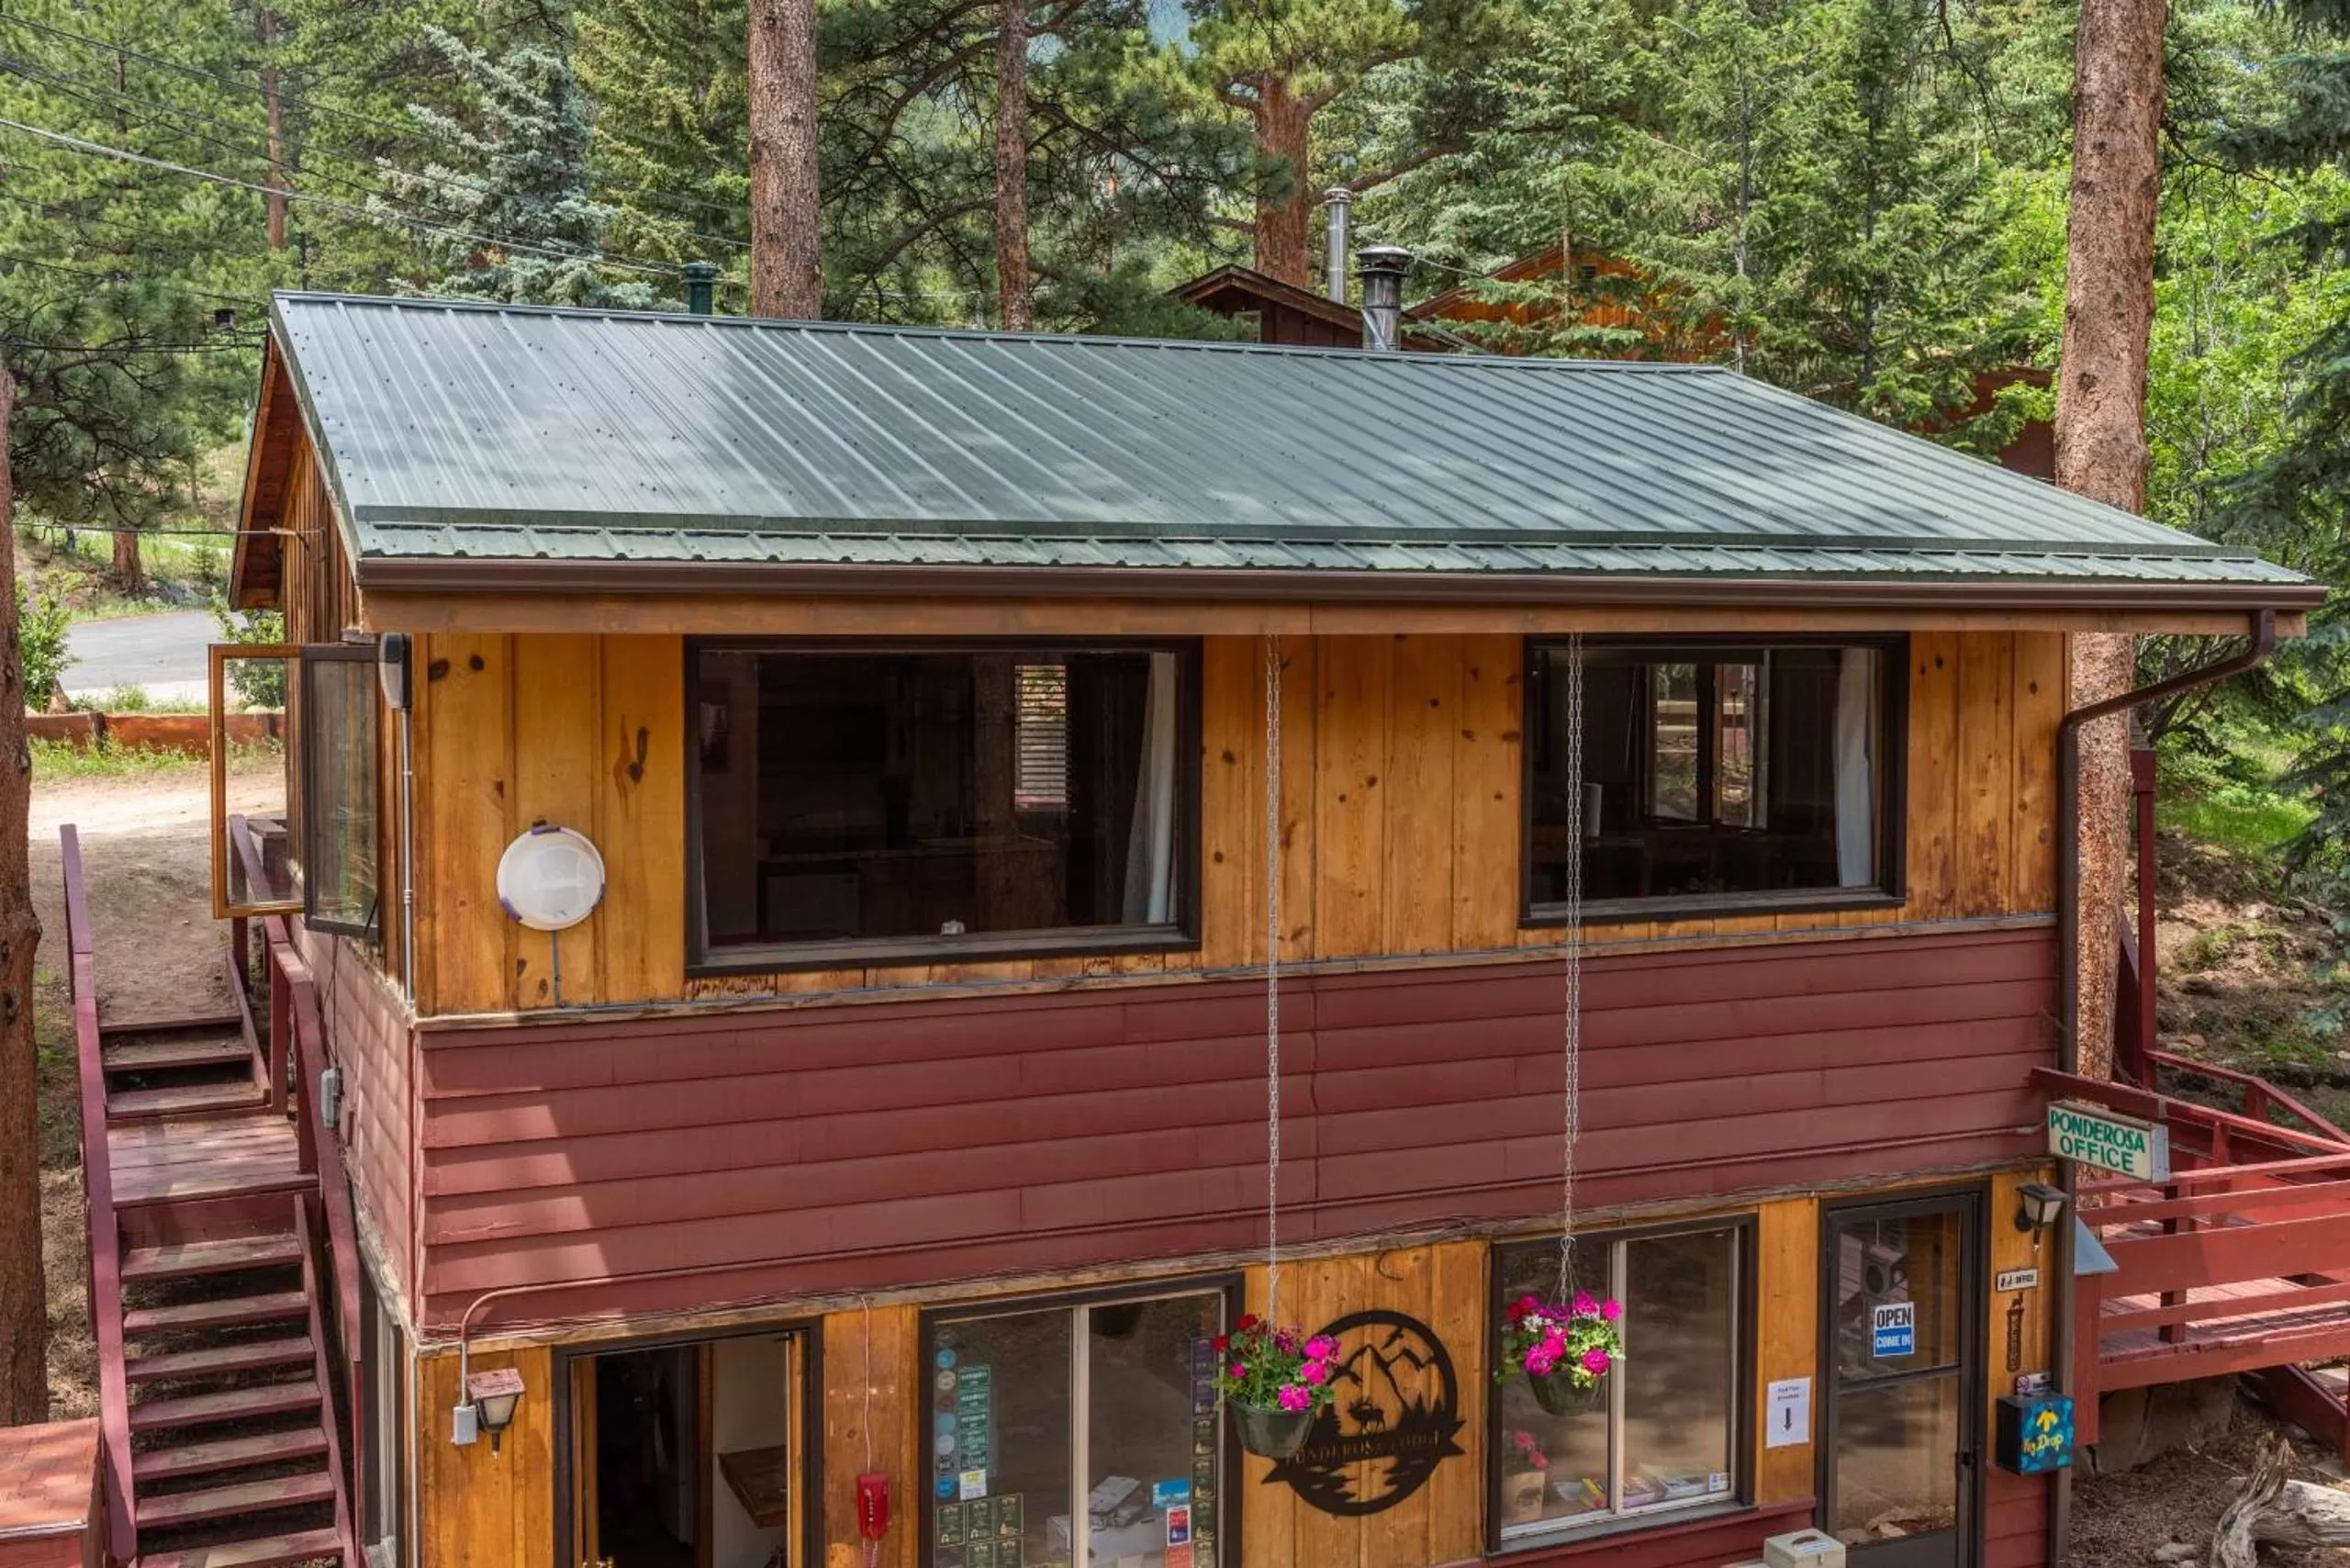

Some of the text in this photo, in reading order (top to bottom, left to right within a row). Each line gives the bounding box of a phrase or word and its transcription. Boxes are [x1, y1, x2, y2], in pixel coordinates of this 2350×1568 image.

[2050, 1109, 2145, 1153] PONDEROSA
[2059, 1135, 2134, 1172] OFFICE
[1876, 1307, 1911, 1327] OPEN
[1876, 1335, 1900, 1348] COME
[2037, 1433, 2064, 1451] Drop
